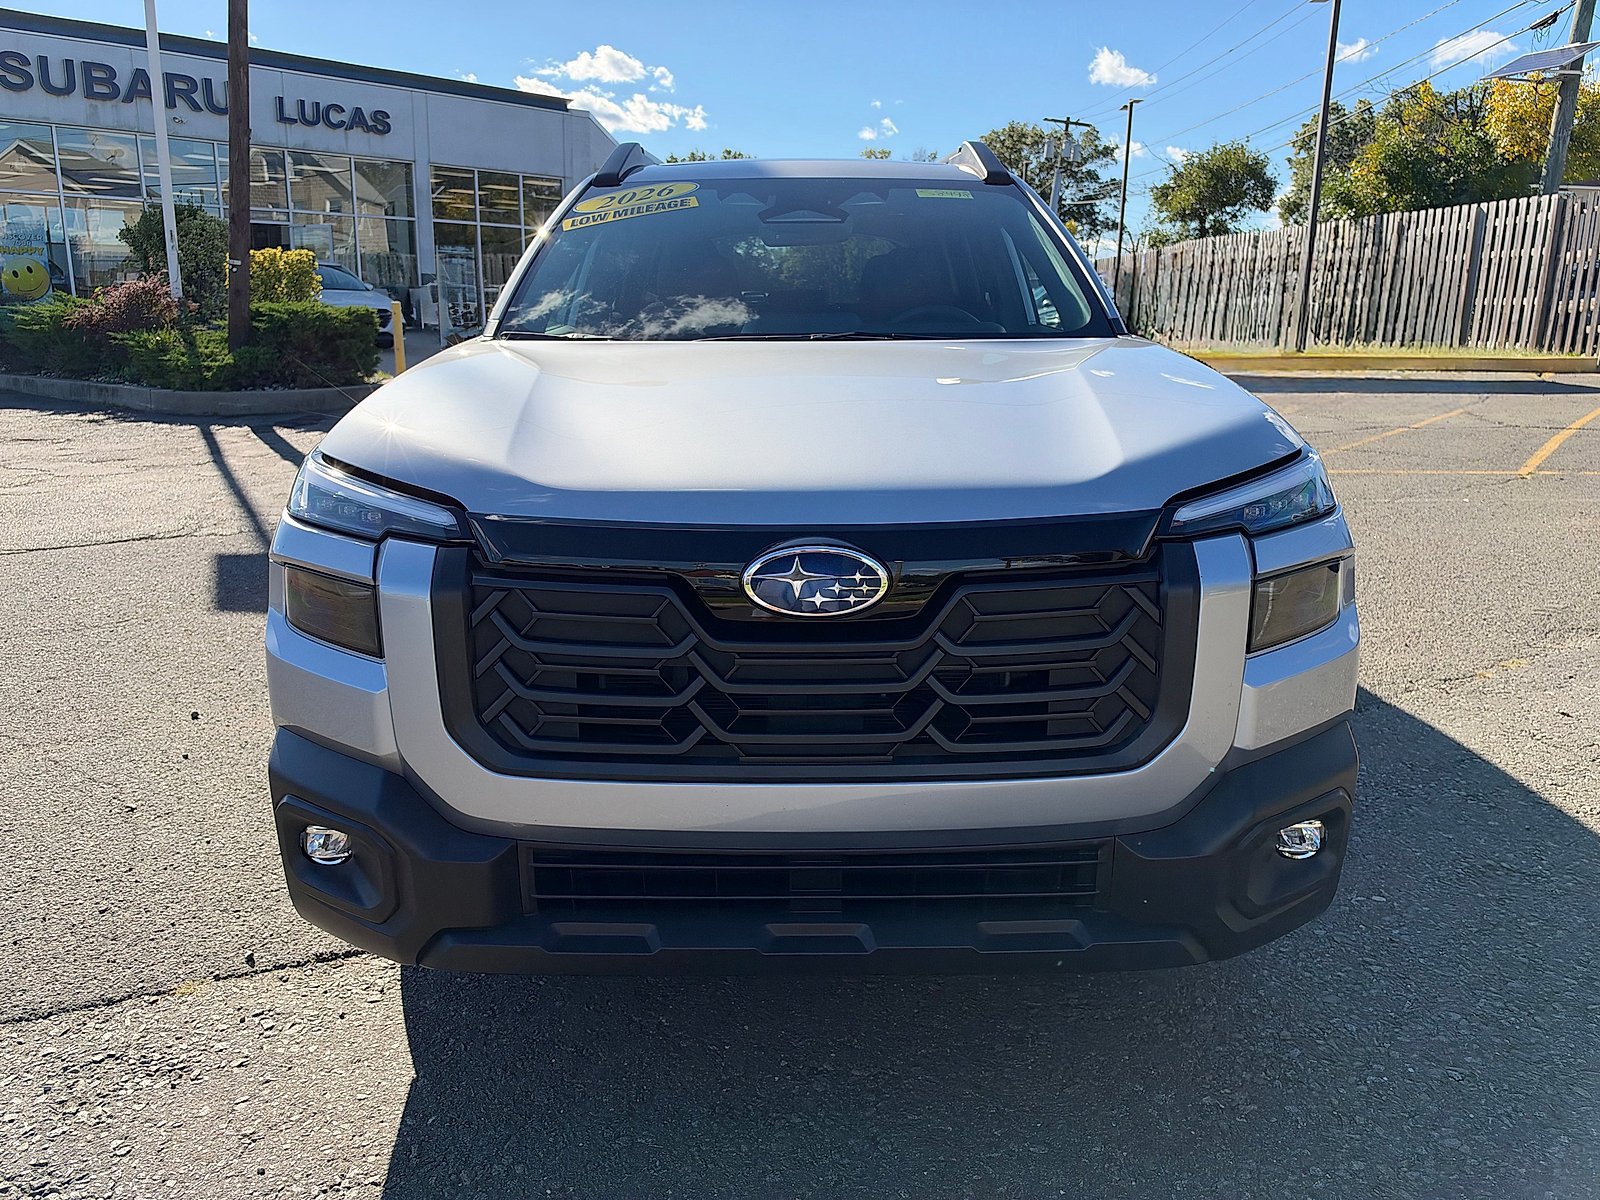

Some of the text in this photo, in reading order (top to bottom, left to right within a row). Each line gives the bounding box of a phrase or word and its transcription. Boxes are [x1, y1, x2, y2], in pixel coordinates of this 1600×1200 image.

[0, 50, 229, 115] SUBARU
[275, 95, 391, 135] LUCAS
[570, 199, 691, 228] LOW MILEAGE
[596, 184, 675, 210] 2026
